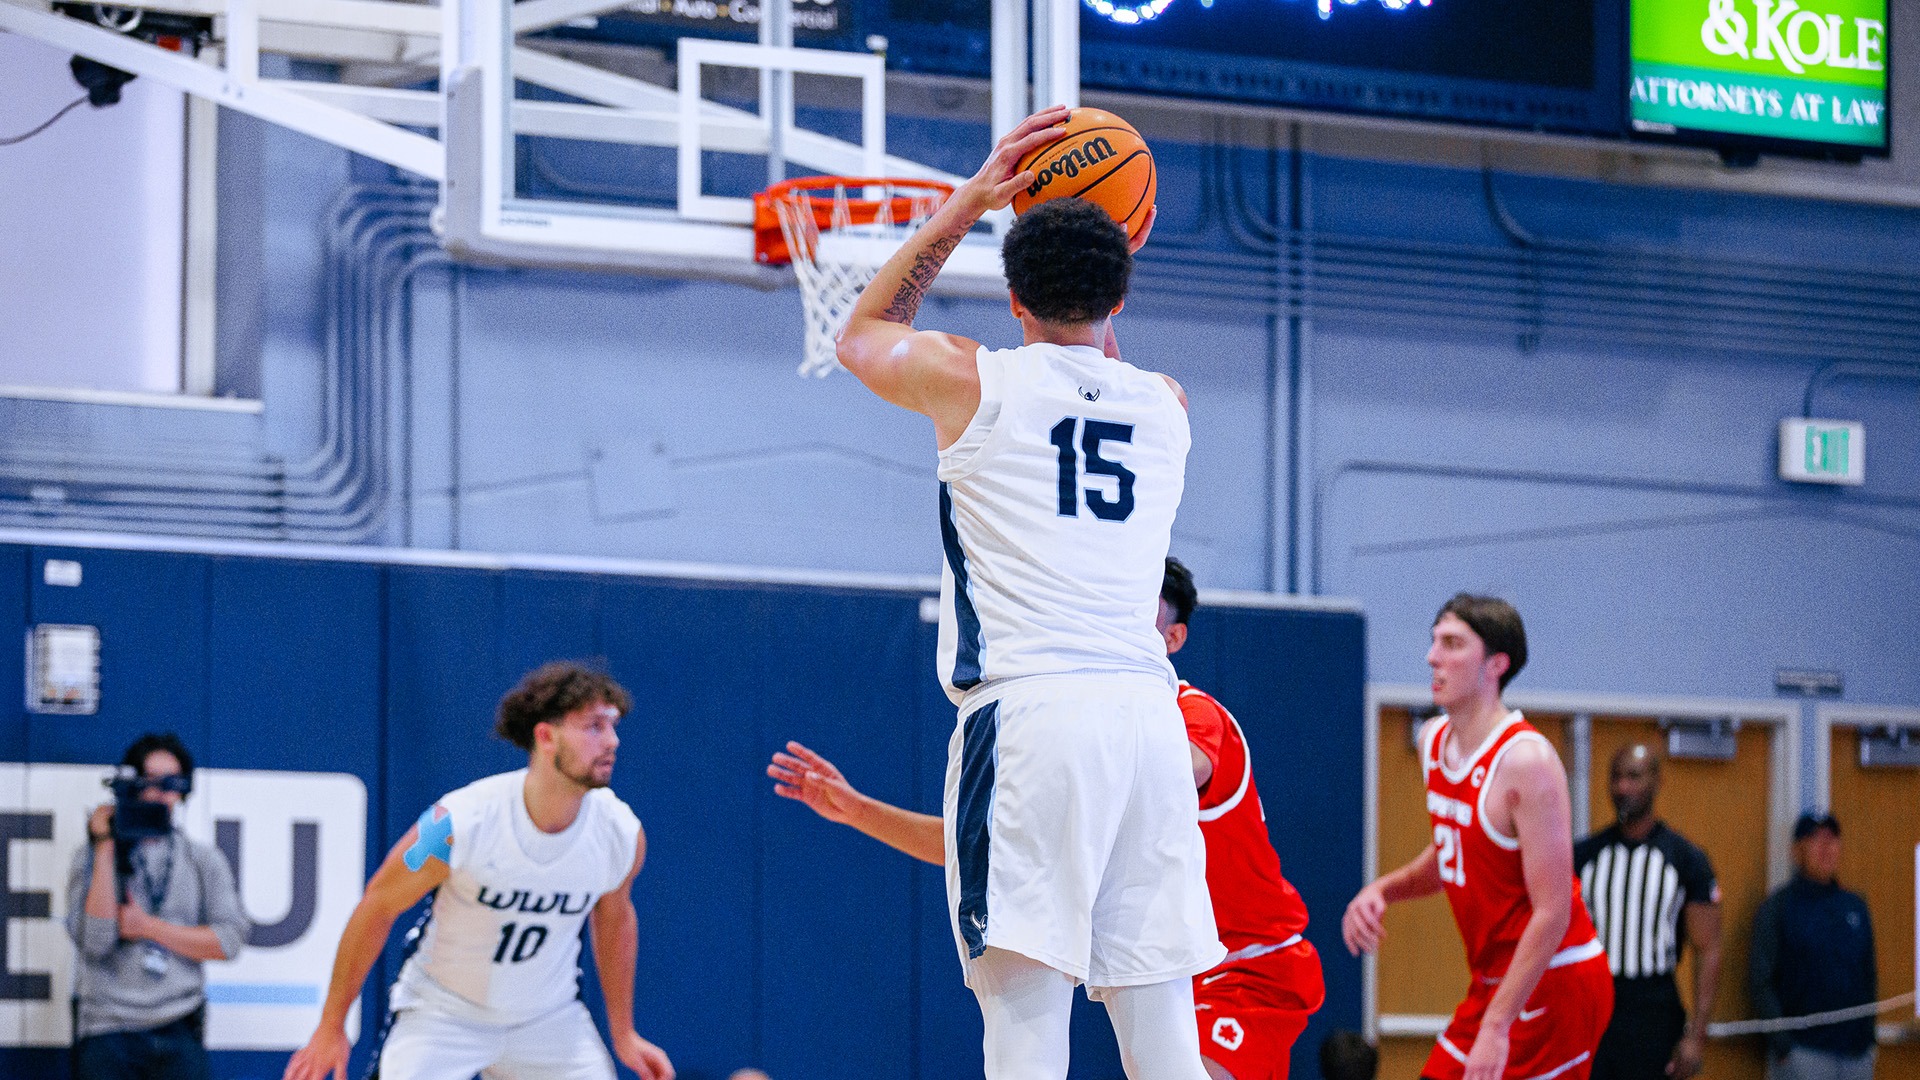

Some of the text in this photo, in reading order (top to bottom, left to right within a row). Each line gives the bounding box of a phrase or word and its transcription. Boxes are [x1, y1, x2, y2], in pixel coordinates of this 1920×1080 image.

[1630, 75, 1884, 126] ATTORNEYS AT LAW
[1026, 137, 1118, 197] Wilson
[1049, 415, 1136, 523] 15
[1804, 425, 1849, 476] EXIT
[1434, 823, 1466, 887] 21
[493, 921, 548, 963] 10
